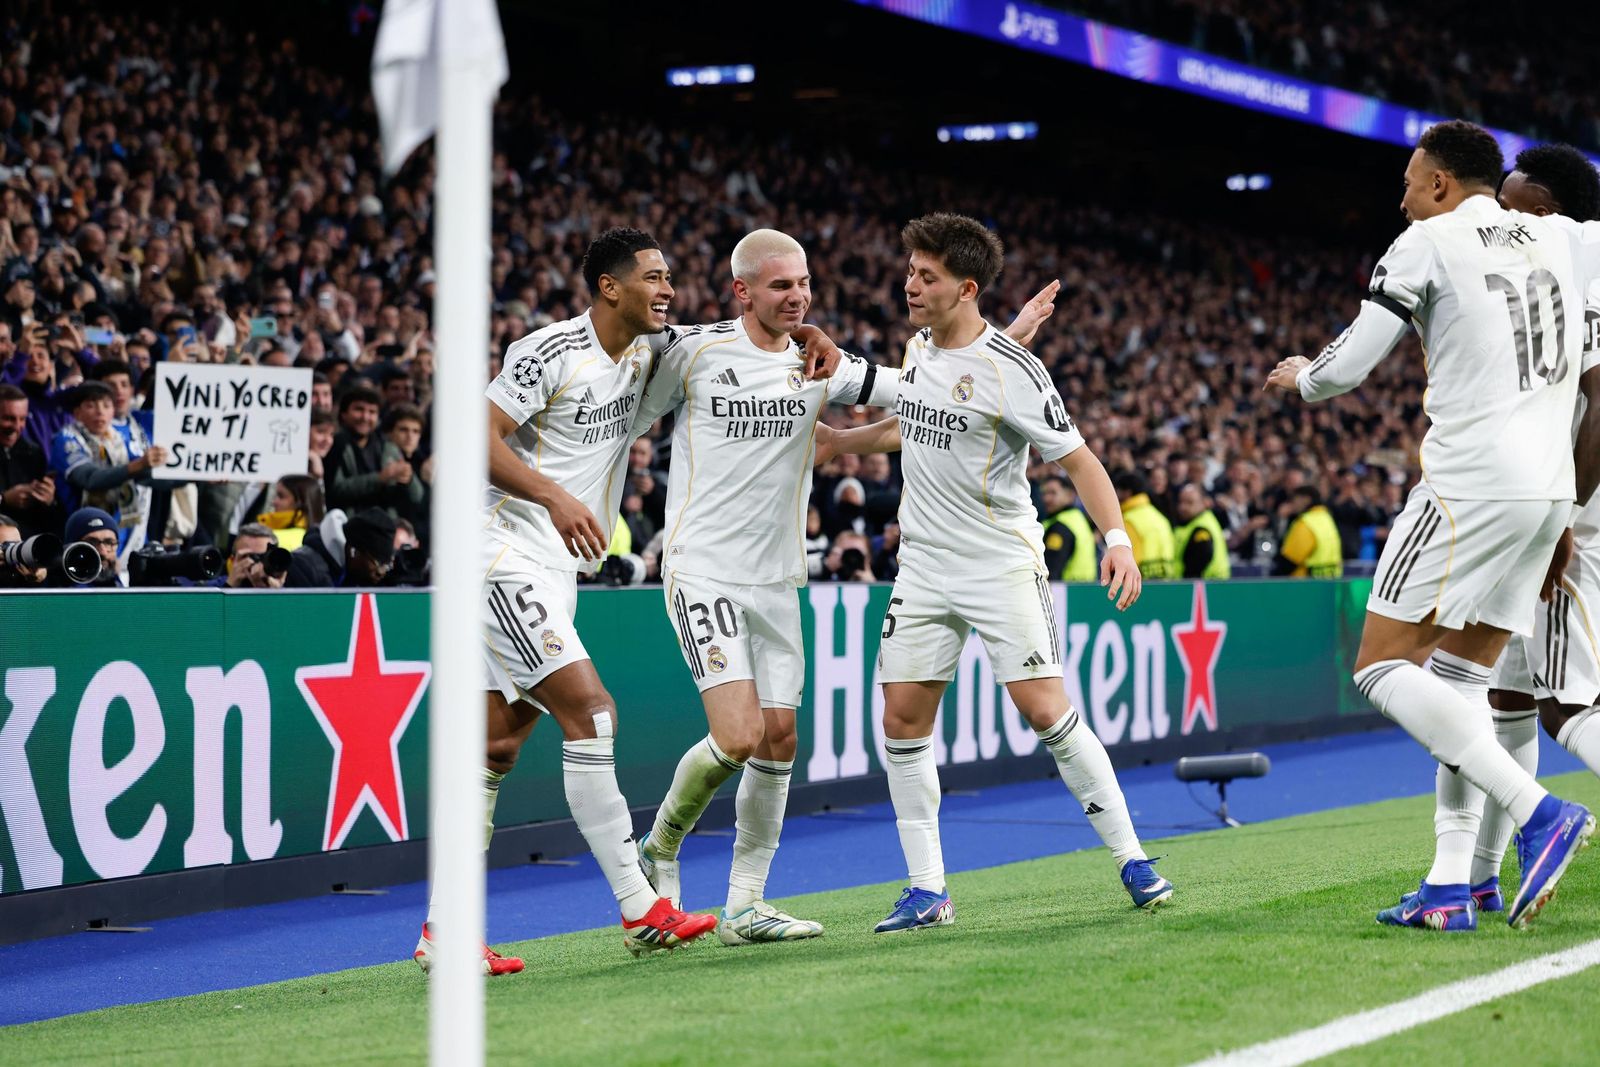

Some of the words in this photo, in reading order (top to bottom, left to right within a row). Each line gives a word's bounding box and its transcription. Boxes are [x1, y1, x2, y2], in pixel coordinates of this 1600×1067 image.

[1485, 268, 1569, 392] 10
[258, 384, 308, 410] CREO
[574, 393, 636, 425] Emirates
[711, 396, 807, 418] Emirates
[181, 414, 211, 436] EN
[222, 414, 249, 440] TI
[896, 393, 969, 433] Emirates
[582, 426, 601, 444] FLY
[726, 421, 749, 438] FLY
[752, 420, 794, 438] BETTER
[913, 425, 952, 451] BETTER
[165, 442, 261, 474] SIEMPRE
[515, 584, 548, 630] 5
[688, 596, 739, 646] 30
